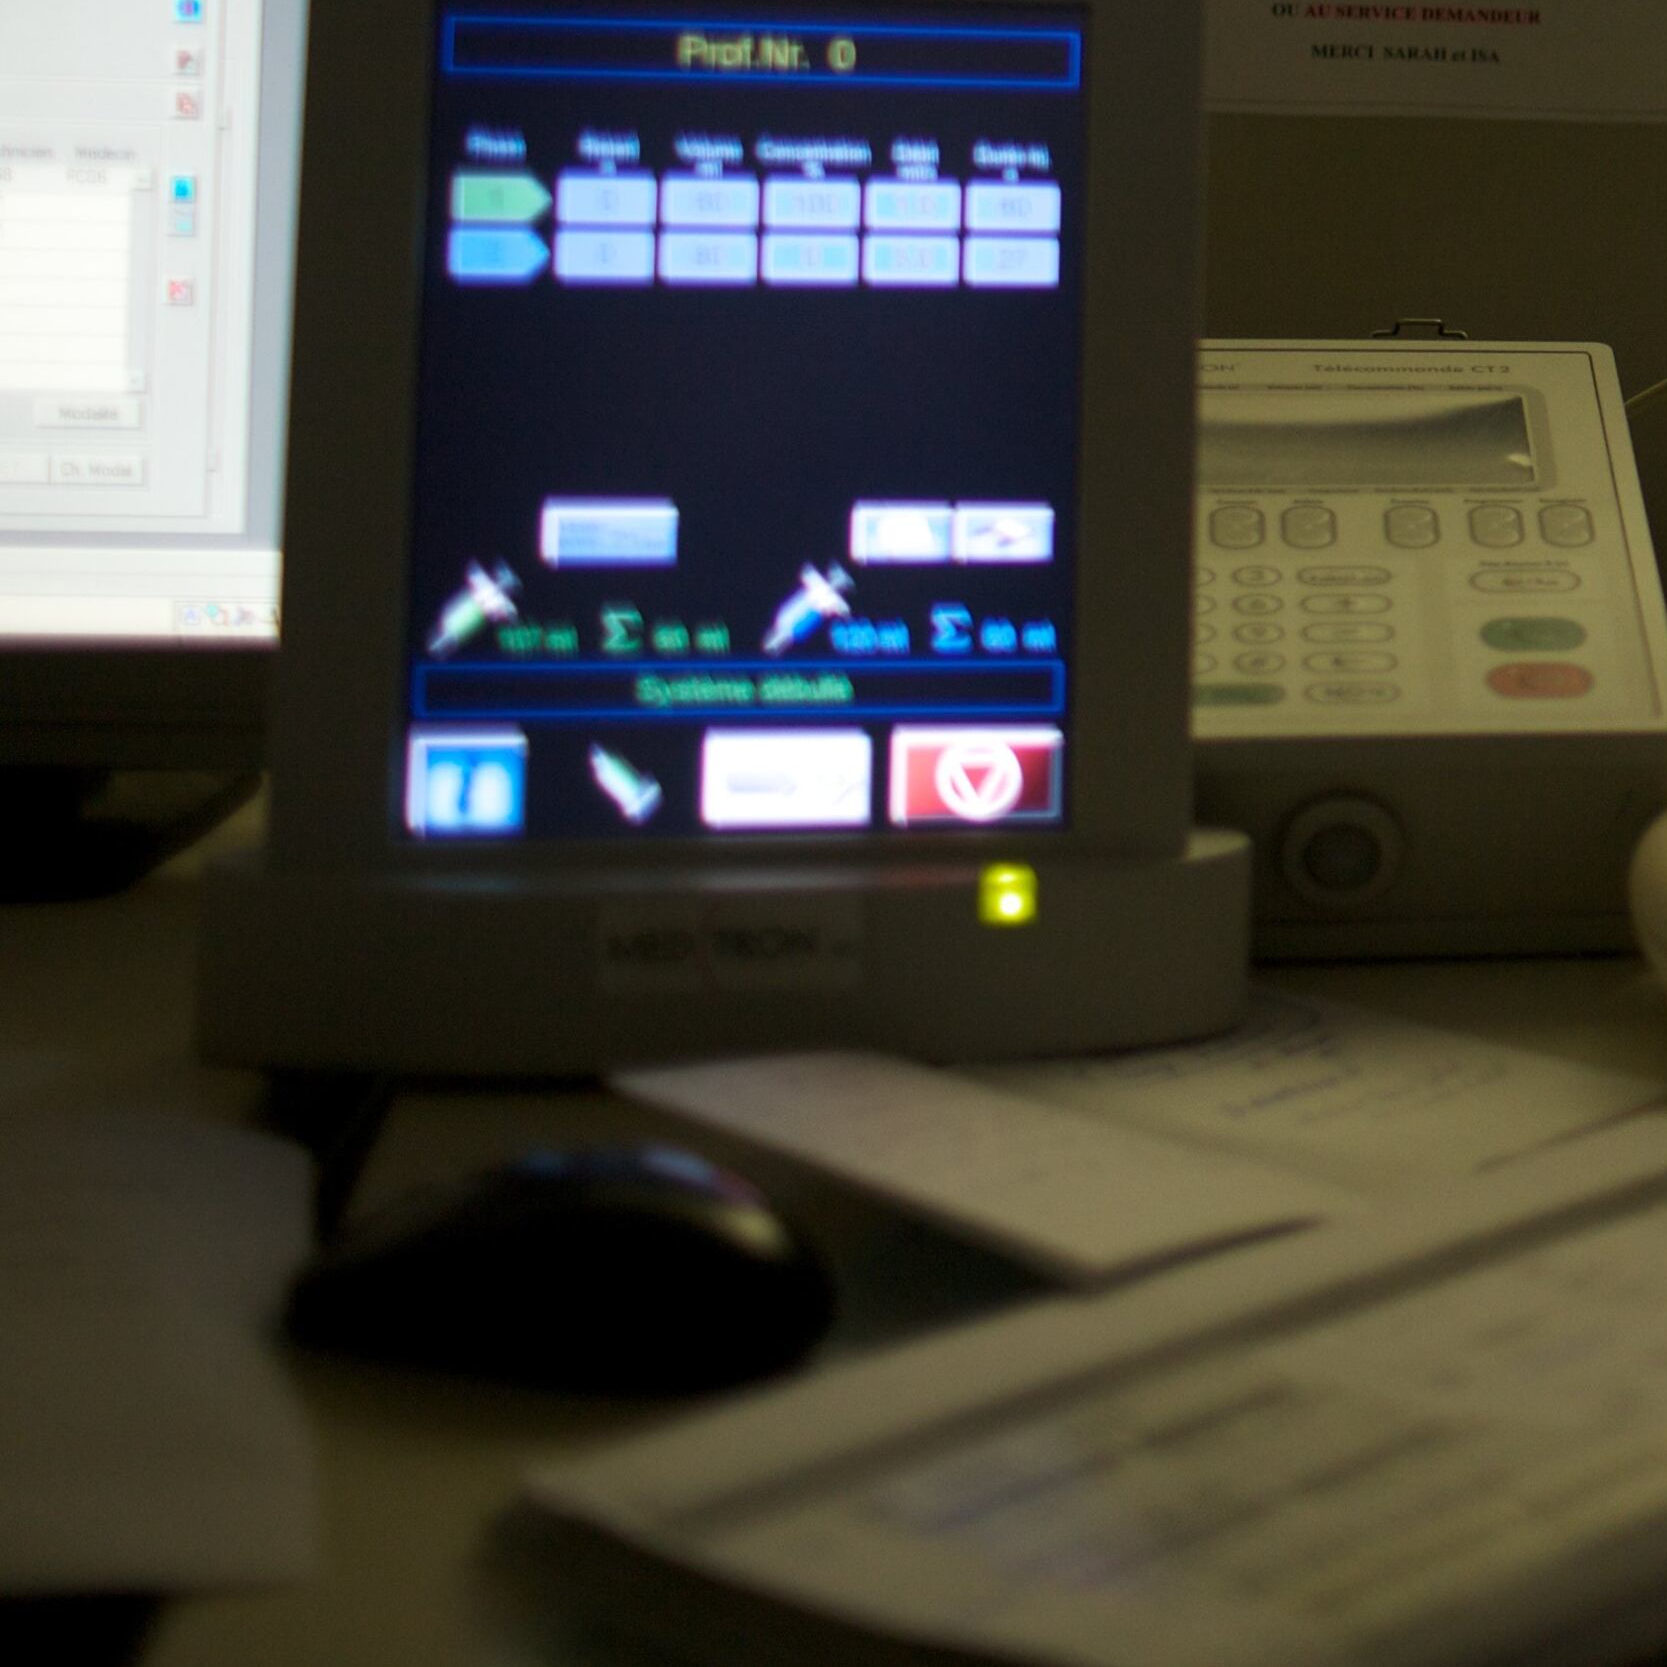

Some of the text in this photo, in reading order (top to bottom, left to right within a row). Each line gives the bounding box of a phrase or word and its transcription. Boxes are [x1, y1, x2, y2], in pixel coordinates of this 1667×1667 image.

[1272, 2, 1541, 23] OU AU SERVICE DEMANDEUR
[1310, 43, 1501, 63] MERCI SARAH et ISA
